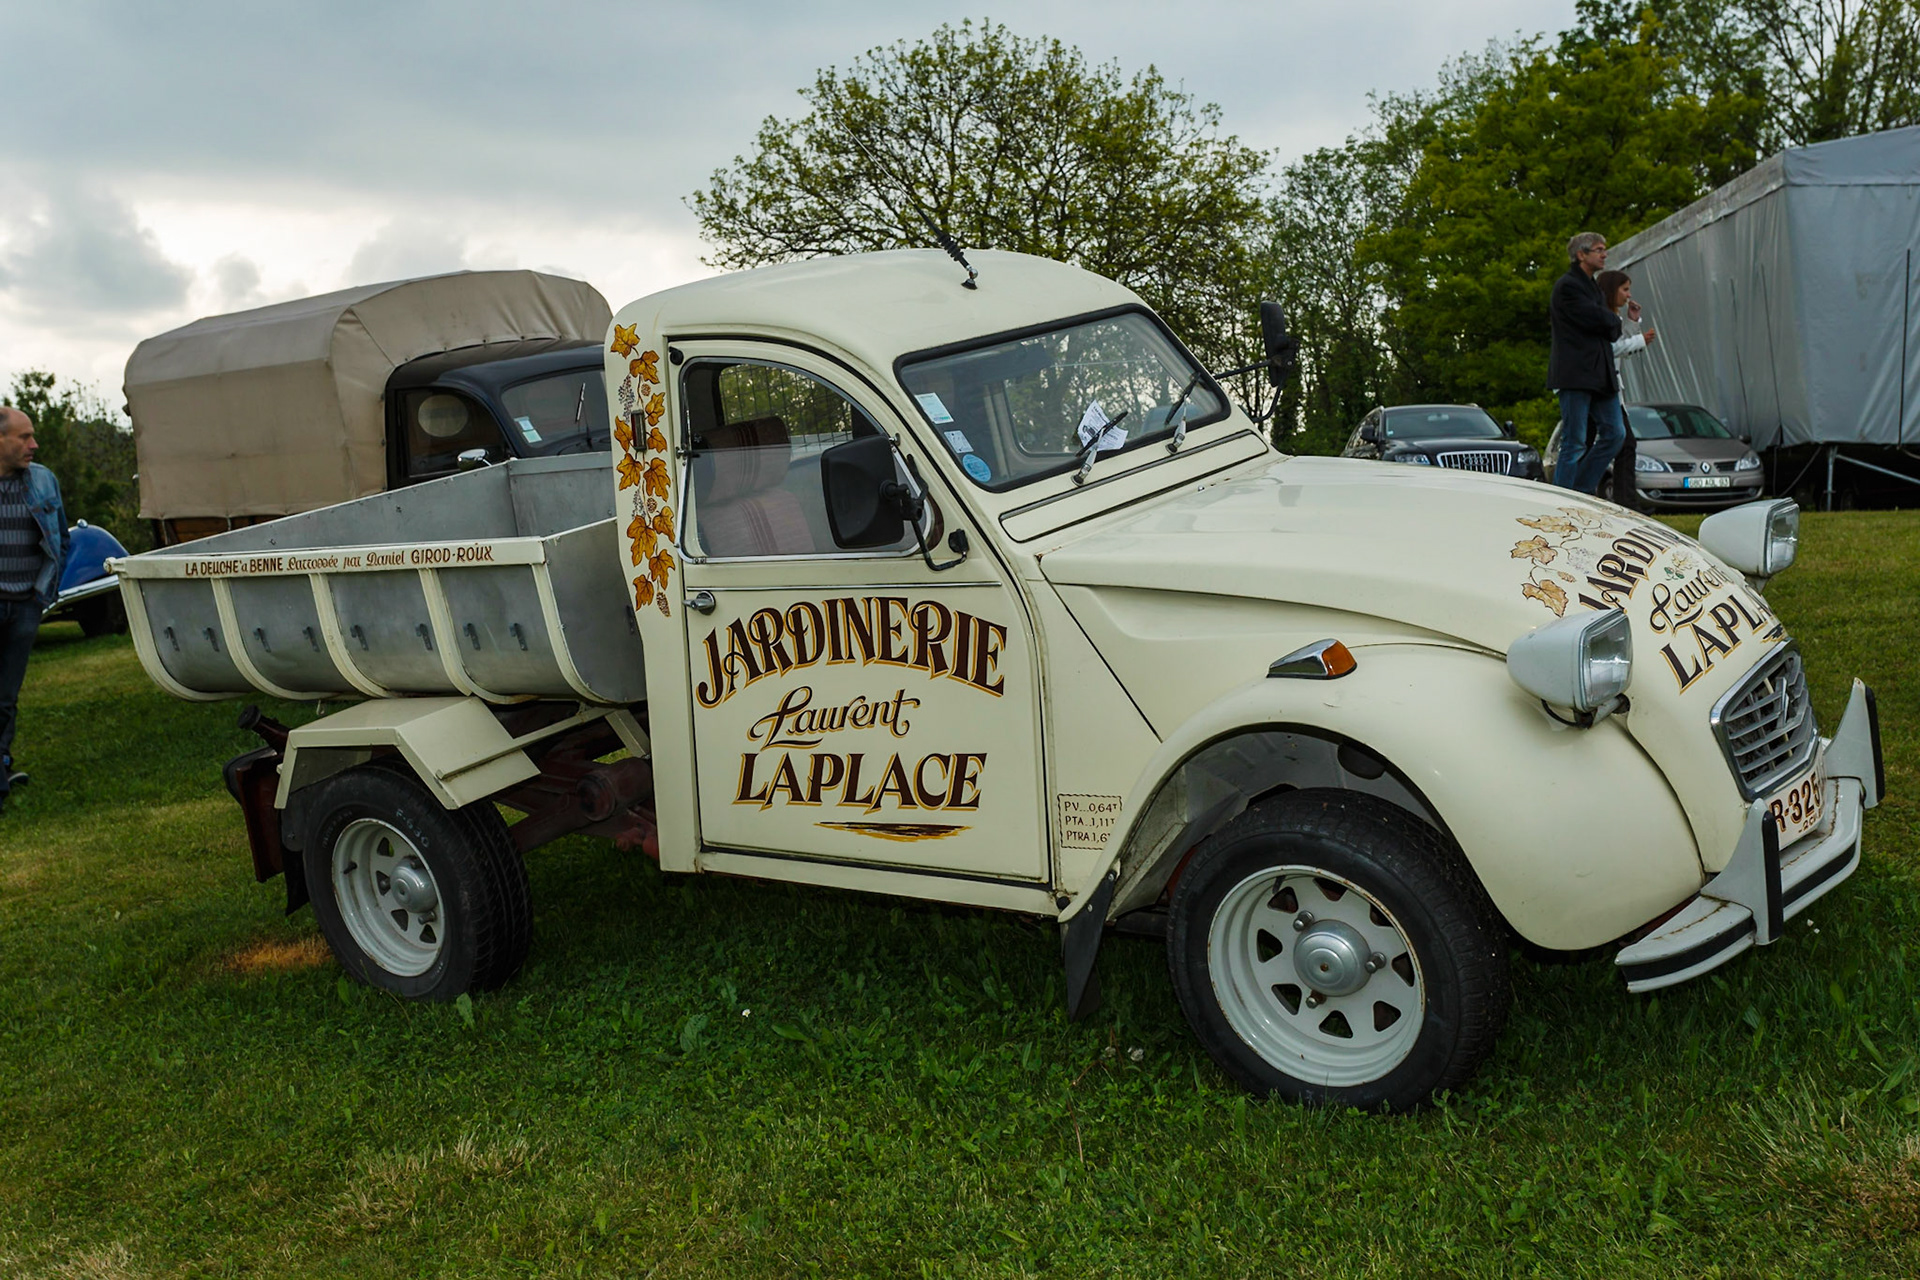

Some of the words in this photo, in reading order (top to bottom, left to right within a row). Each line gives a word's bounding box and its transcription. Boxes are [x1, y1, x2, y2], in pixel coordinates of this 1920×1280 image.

[185, 562, 199, 576] LA
[200, 559, 239, 576] DEUCHE
[249, 557, 284, 573] BENNE
[287, 555, 339, 571] Carrossée
[343, 556, 361, 569] par
[366, 550, 405, 567] Daniel
[411, 546, 495, 565] GIROD-ROUX
[696, 597, 1007, 709] JARDINERIE
[747, 686, 921, 751] Laurent
[732, 752, 987, 816] LAPLACE
